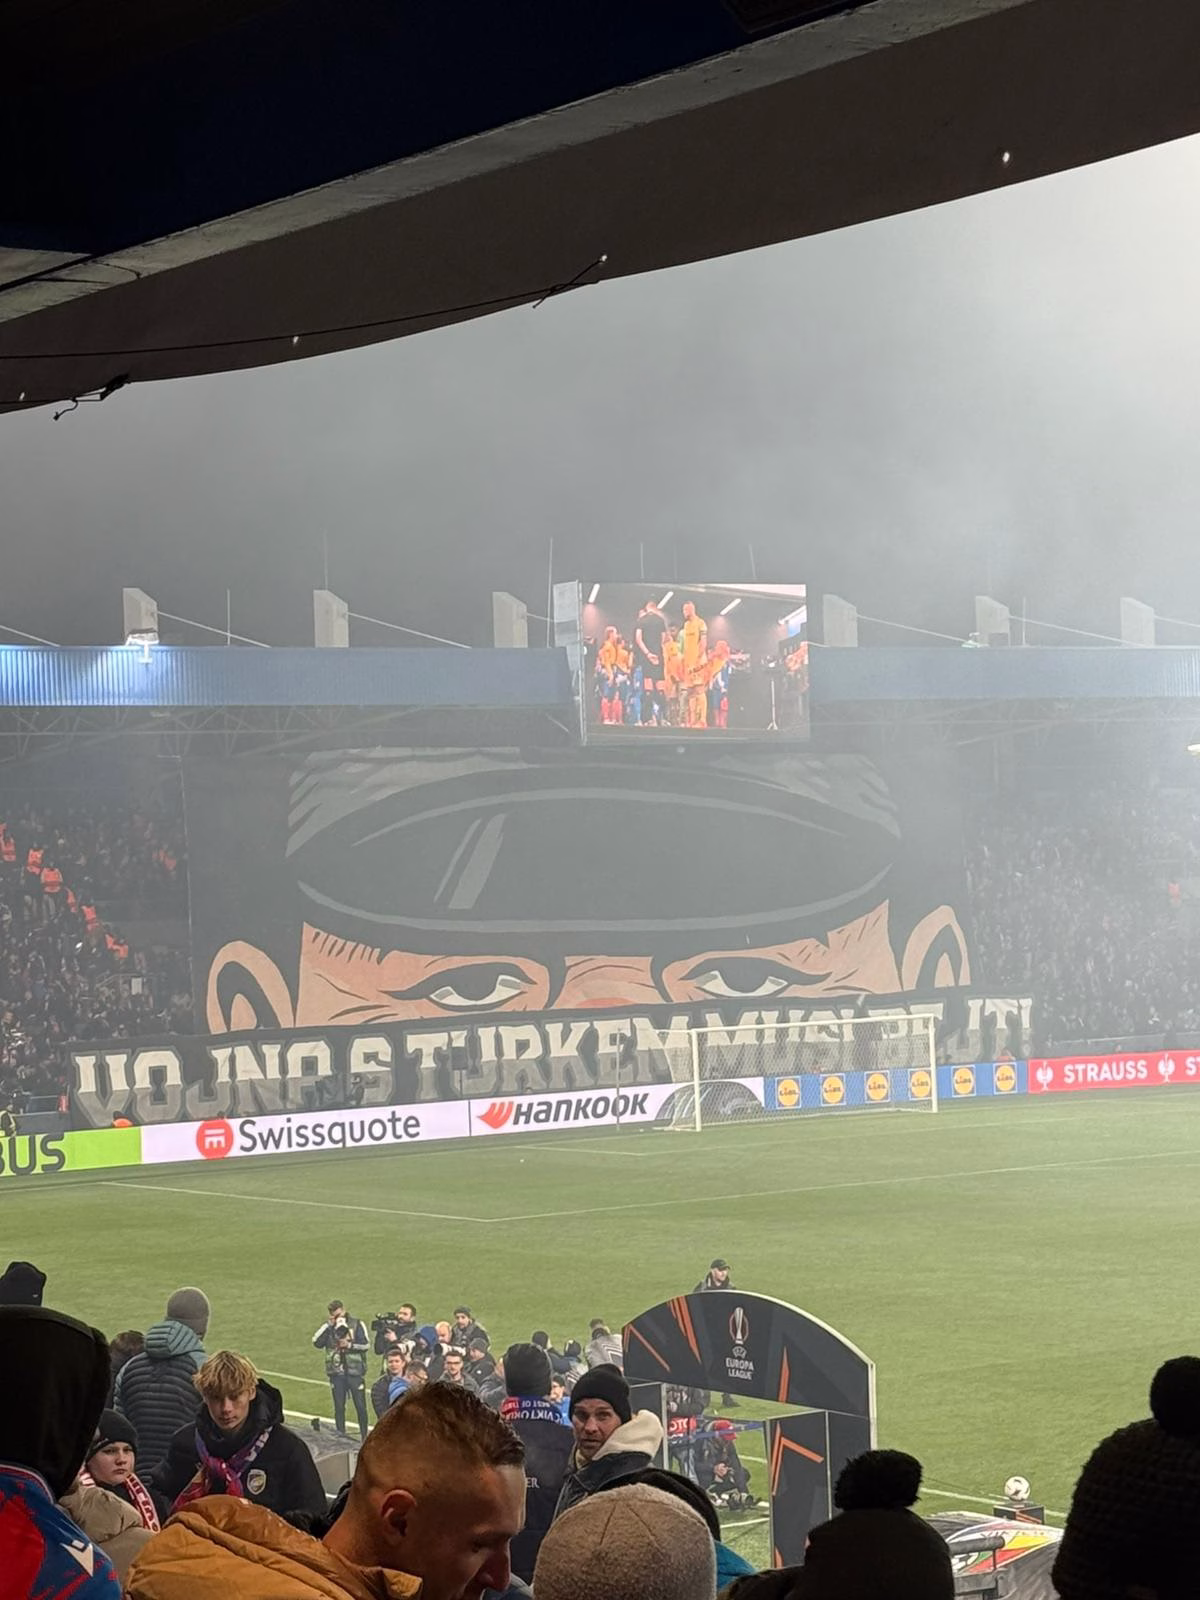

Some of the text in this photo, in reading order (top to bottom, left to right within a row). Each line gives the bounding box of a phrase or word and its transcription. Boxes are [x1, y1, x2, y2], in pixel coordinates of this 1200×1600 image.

[73, 1040, 338, 1127] VOJNA
[350, 1036, 393, 1104] S
[1063, 1059, 1148, 1084] STRAUSS
[239, 1110, 421, 1153] Swissquote
[0, 1131, 66, 1174] US
[725, 1357, 755, 1371] EUROPA
[728, 1369, 753, 1381] LEAGUE
